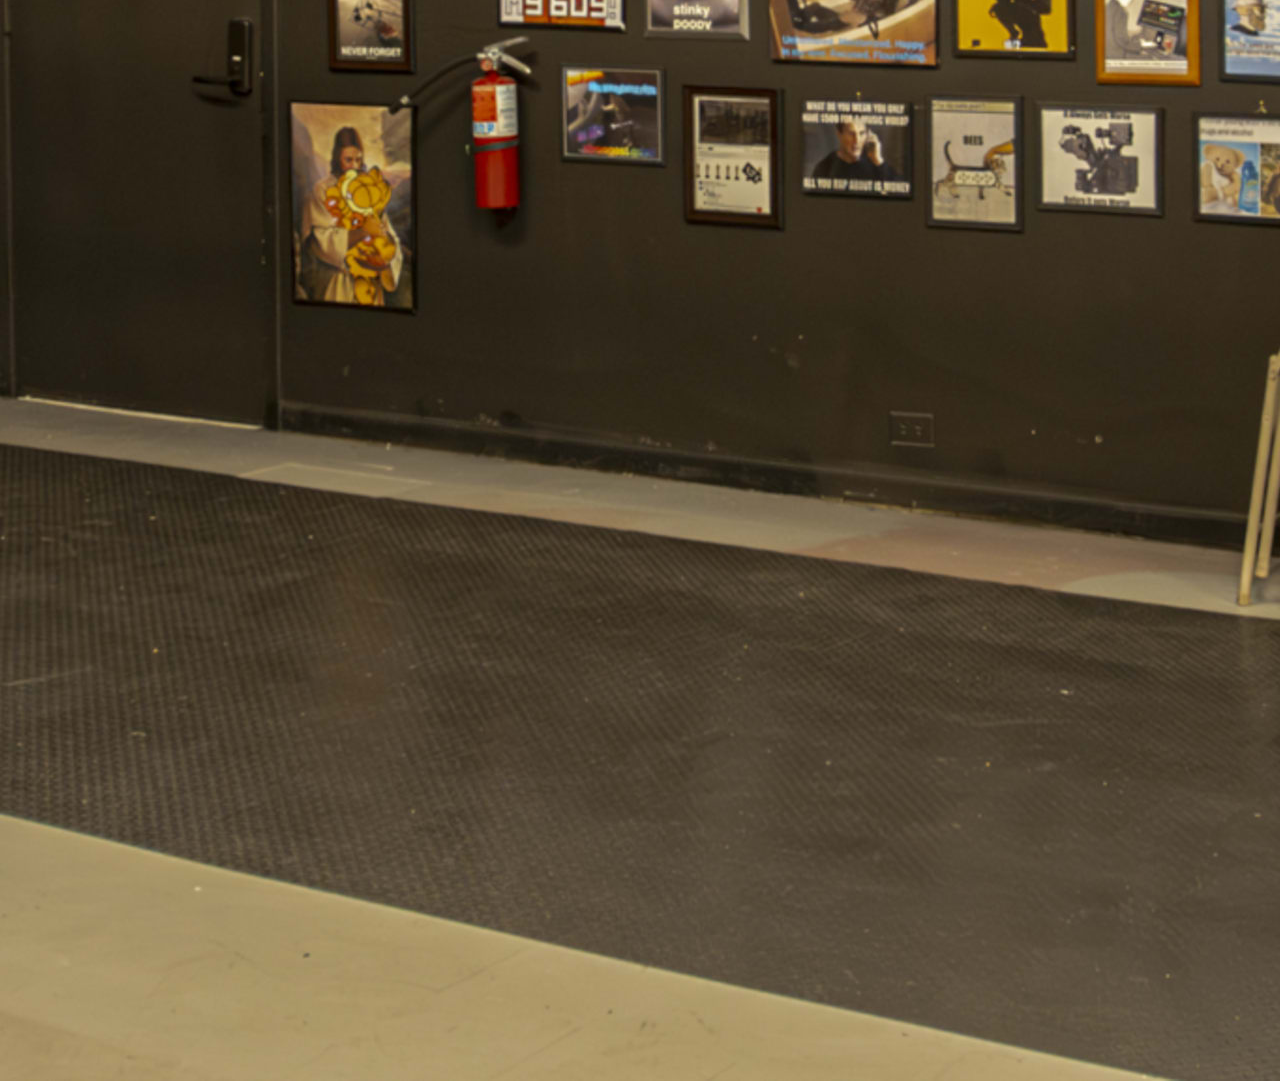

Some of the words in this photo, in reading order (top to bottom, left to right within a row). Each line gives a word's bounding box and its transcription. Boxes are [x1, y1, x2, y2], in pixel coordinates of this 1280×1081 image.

[672, 4, 711, 19] stinky
[340, 45, 367, 57] NEVER
[368, 46, 402, 58] FORGET
